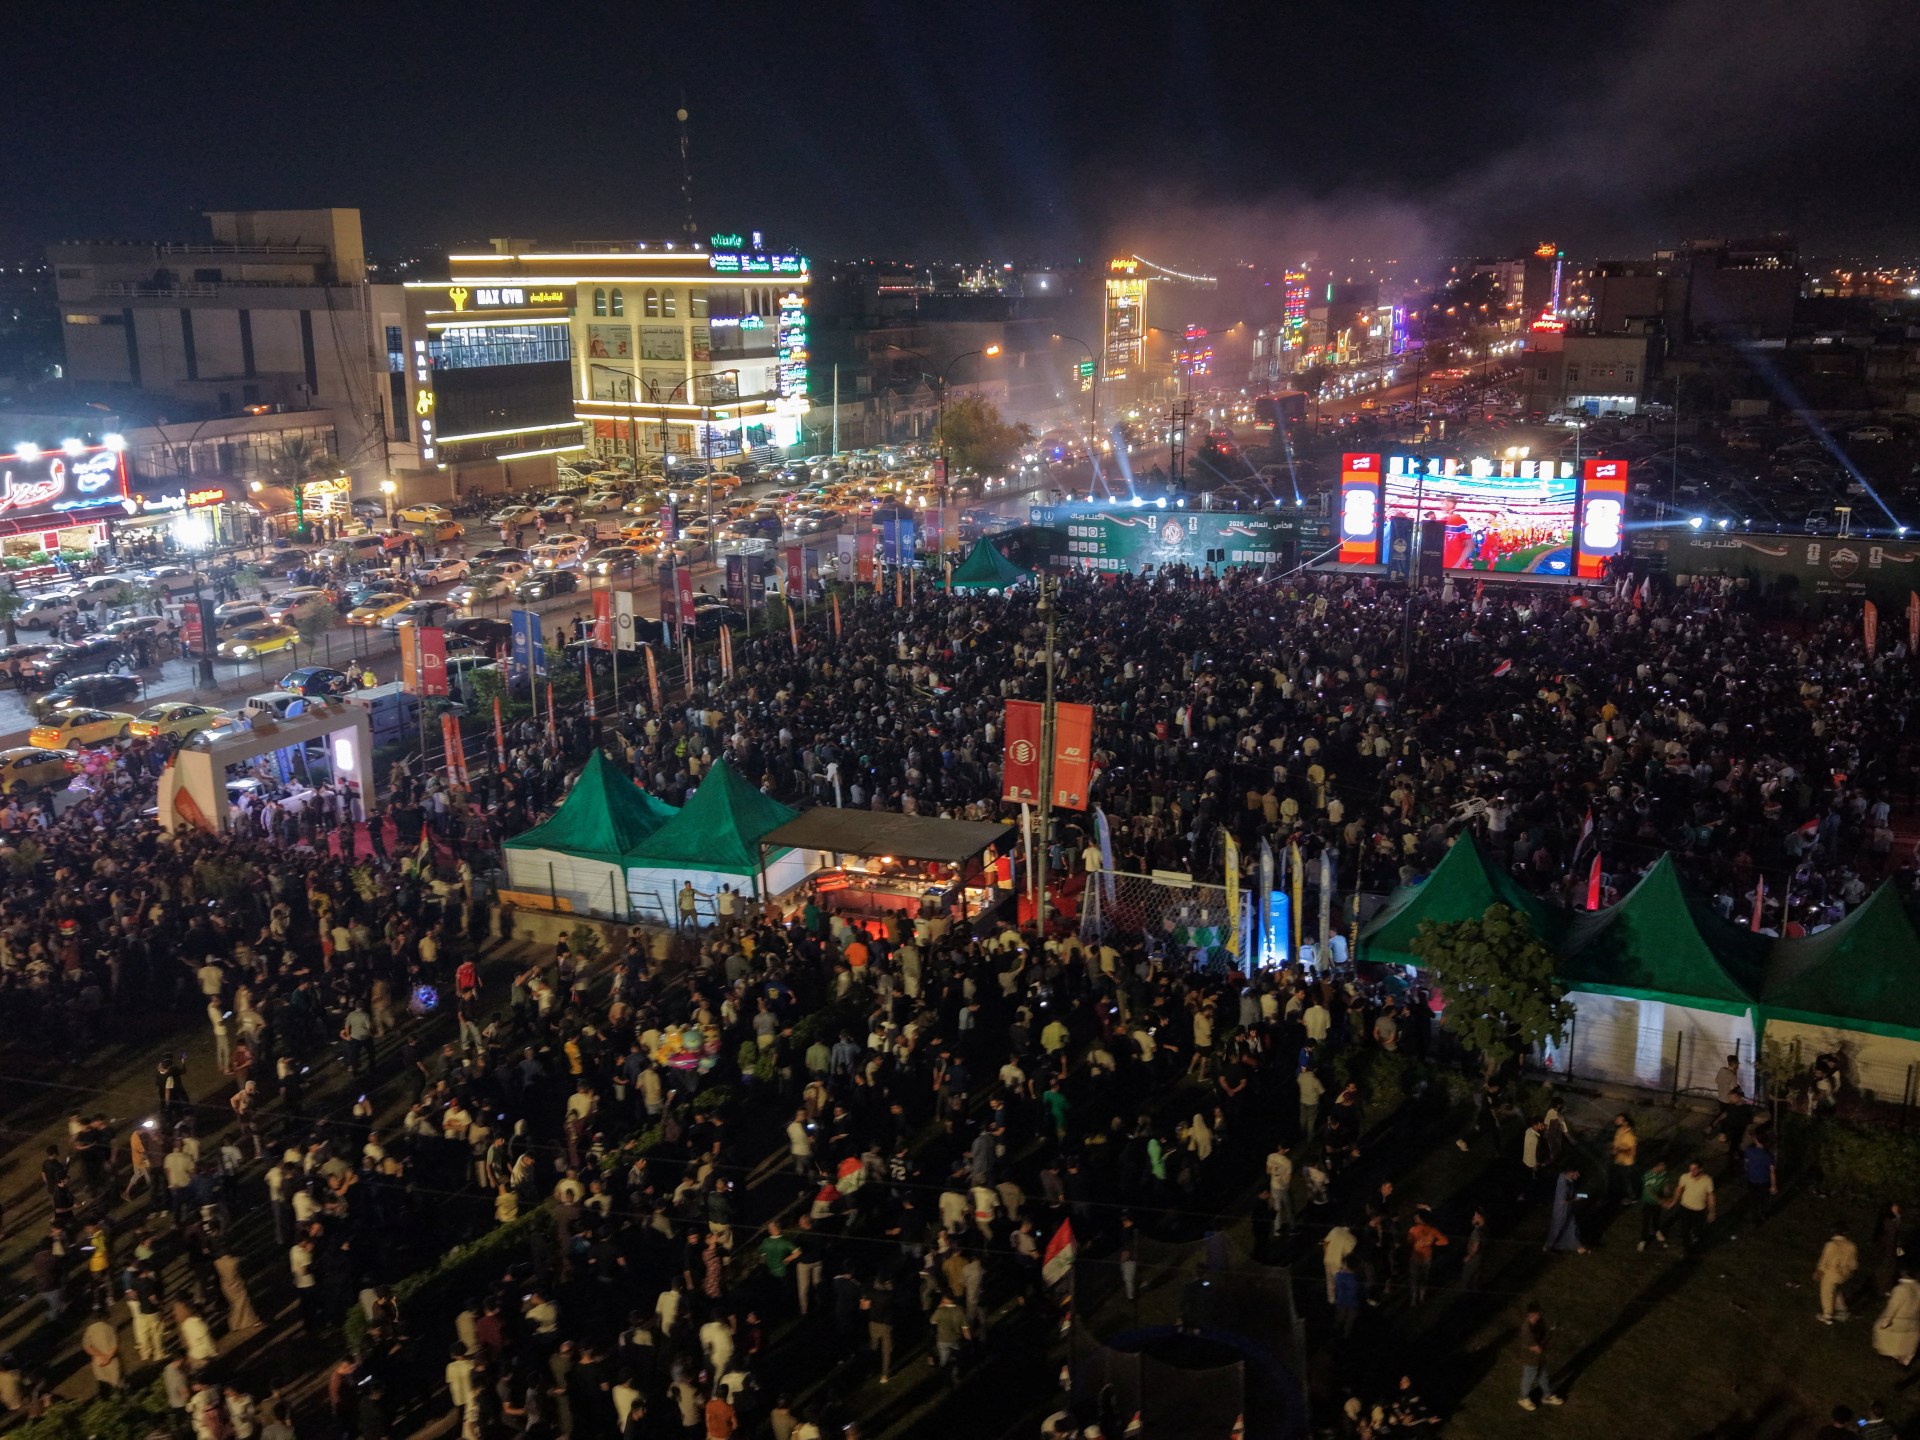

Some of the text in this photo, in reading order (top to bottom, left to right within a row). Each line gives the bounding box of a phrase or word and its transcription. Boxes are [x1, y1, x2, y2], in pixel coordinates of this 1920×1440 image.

[476, 289, 524, 304] MAX GYM
[415, 341, 427, 381] MAX
[422, 420, 434, 459] GYM
